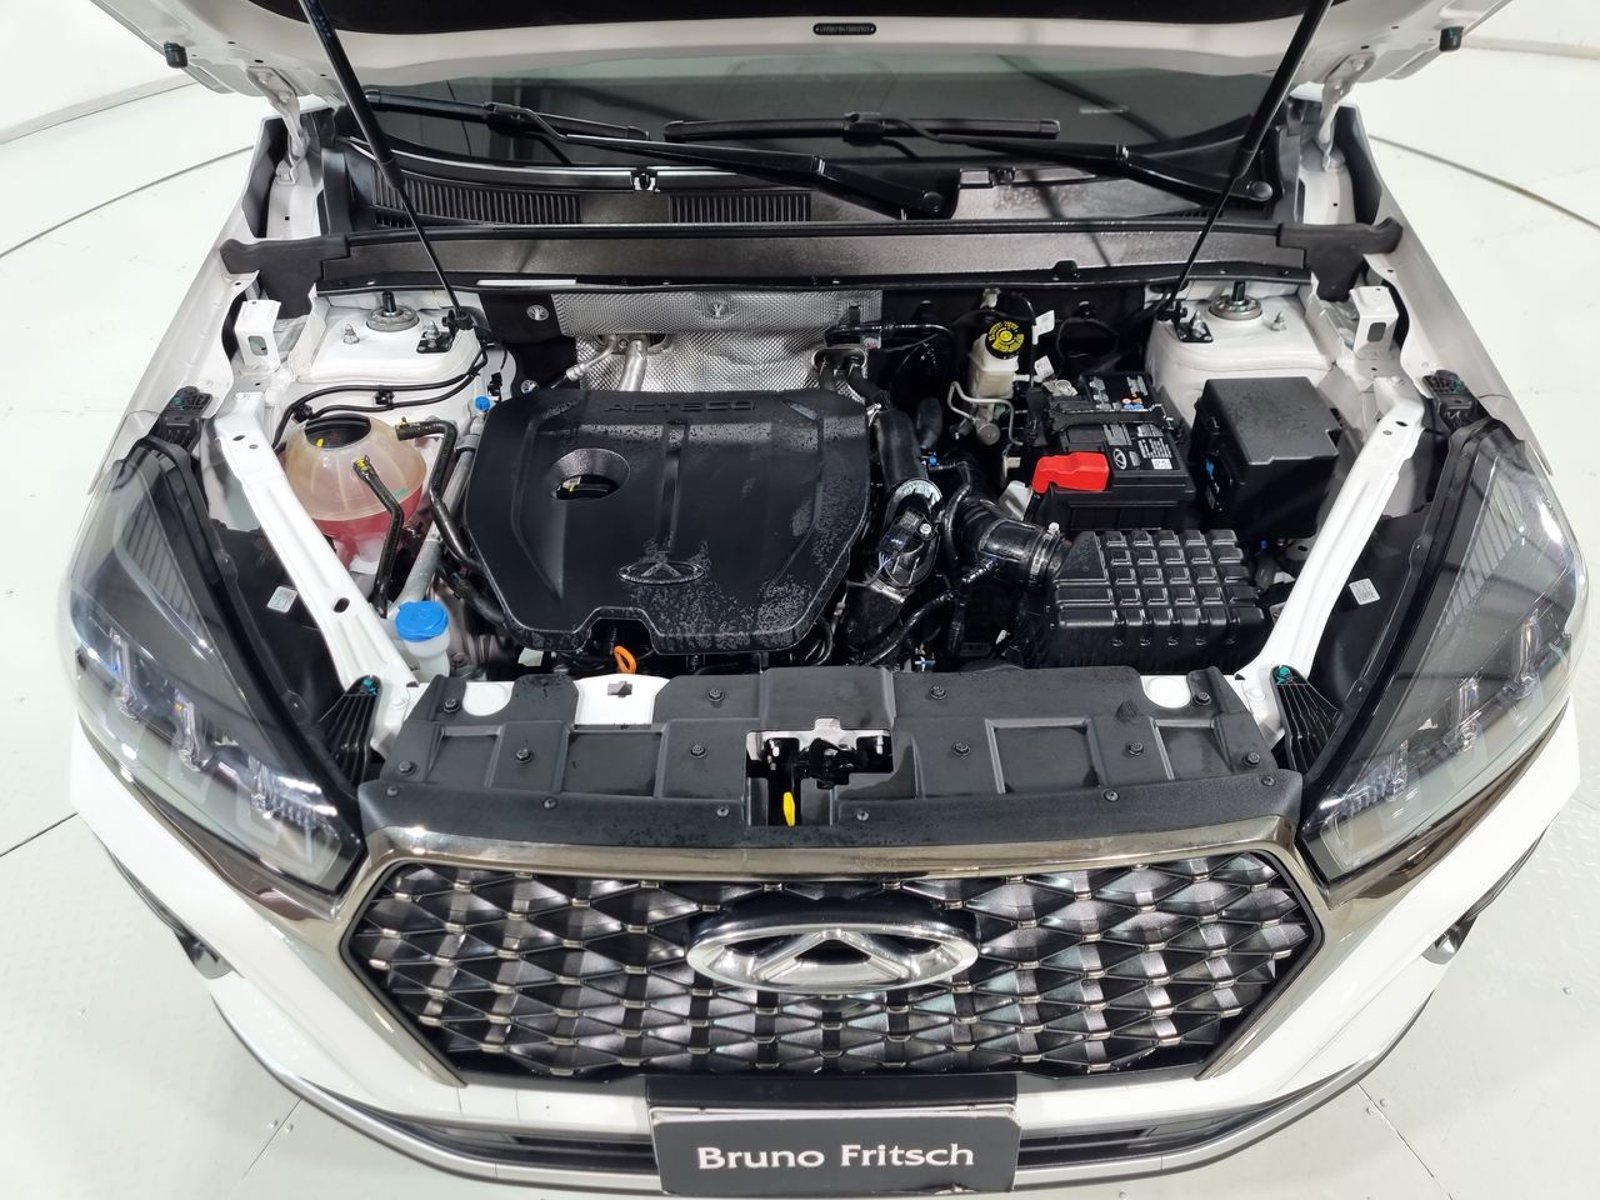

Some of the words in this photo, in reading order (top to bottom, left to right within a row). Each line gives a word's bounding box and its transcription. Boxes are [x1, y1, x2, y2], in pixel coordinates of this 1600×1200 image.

[604, 401, 755, 413] ACTECO
[697, 1147, 825, 1169] Bruno
[840, 1143, 975, 1167] Fritsch
